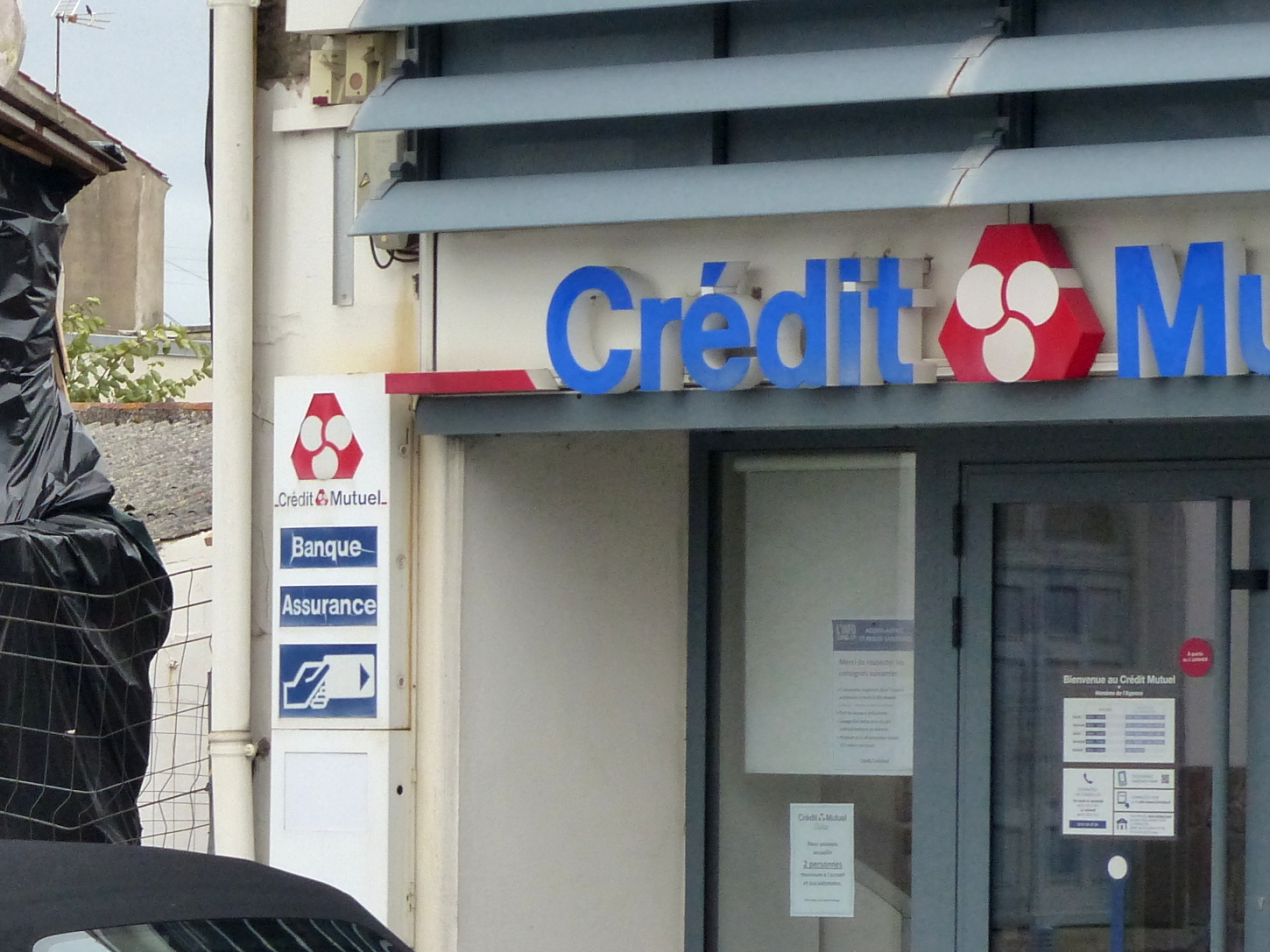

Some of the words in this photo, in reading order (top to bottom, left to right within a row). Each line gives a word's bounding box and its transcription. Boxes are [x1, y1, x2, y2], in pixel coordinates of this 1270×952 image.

[546, 257, 914, 395] Crédit
[278, 491, 314, 507] Crédit
[330, 490, 381, 506] Mutuel
[291, 536, 362, 562] Banque
[281, 594, 377, 616] Assurance
[1063, 675, 1106, 685] Bienvenue
[1107, 676, 1118, 685] au
[1119, 674, 1145, 685] Crédit
[1147, 675, 1176, 685] Mutuel
[798, 813, 818, 822] Crédit
[825, 813, 847, 822] Mutuel
[808, 861, 843, 869] personnes
